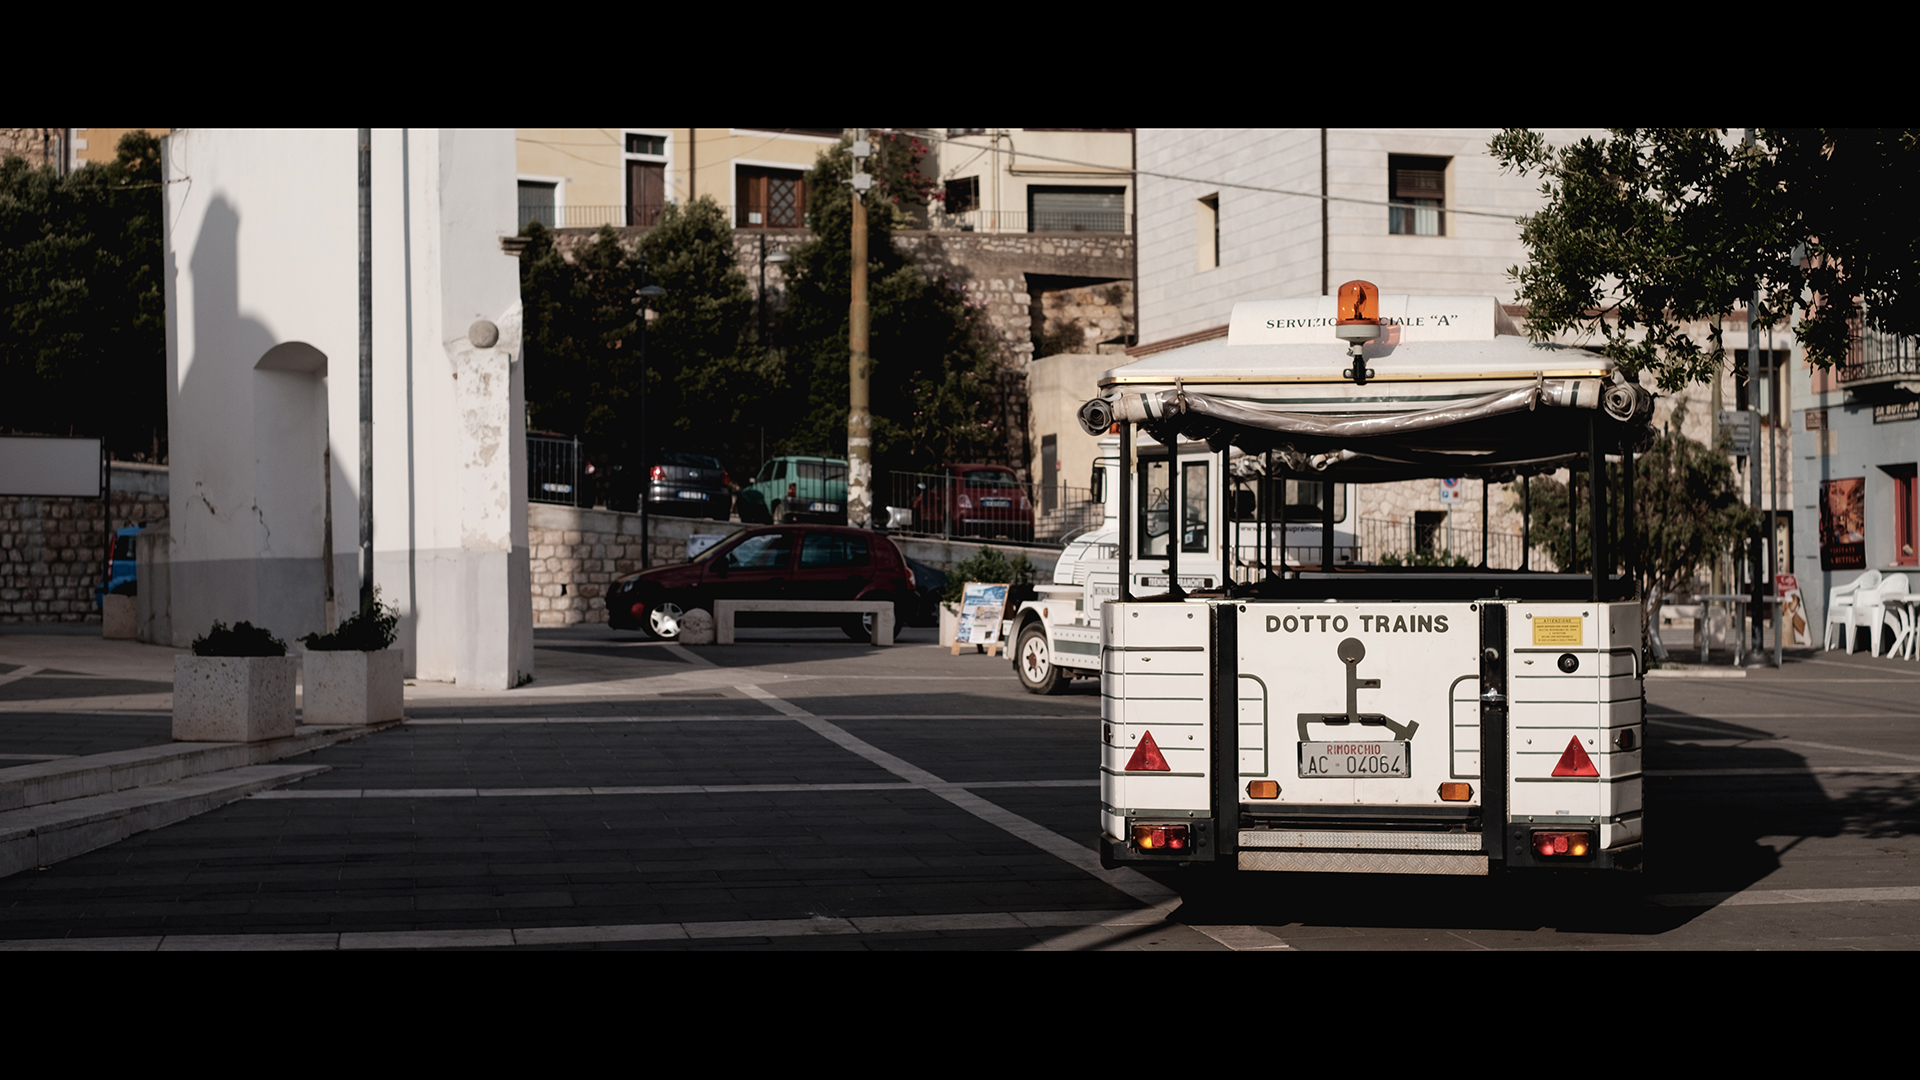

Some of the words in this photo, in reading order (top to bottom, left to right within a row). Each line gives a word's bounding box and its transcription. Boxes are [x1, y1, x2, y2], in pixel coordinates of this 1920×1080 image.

[1266, 317, 1338, 328] SERVIZIO
[1378, 316, 1425, 327] CIALE
[1265, 614, 1349, 633] DOTTO
[1359, 614, 1449, 633] TRAINS
[1326, 744, 1381, 755] RIMORCHIO
[1308, 755, 1329, 774] AC
[1346, 755, 1401, 774] 04064
